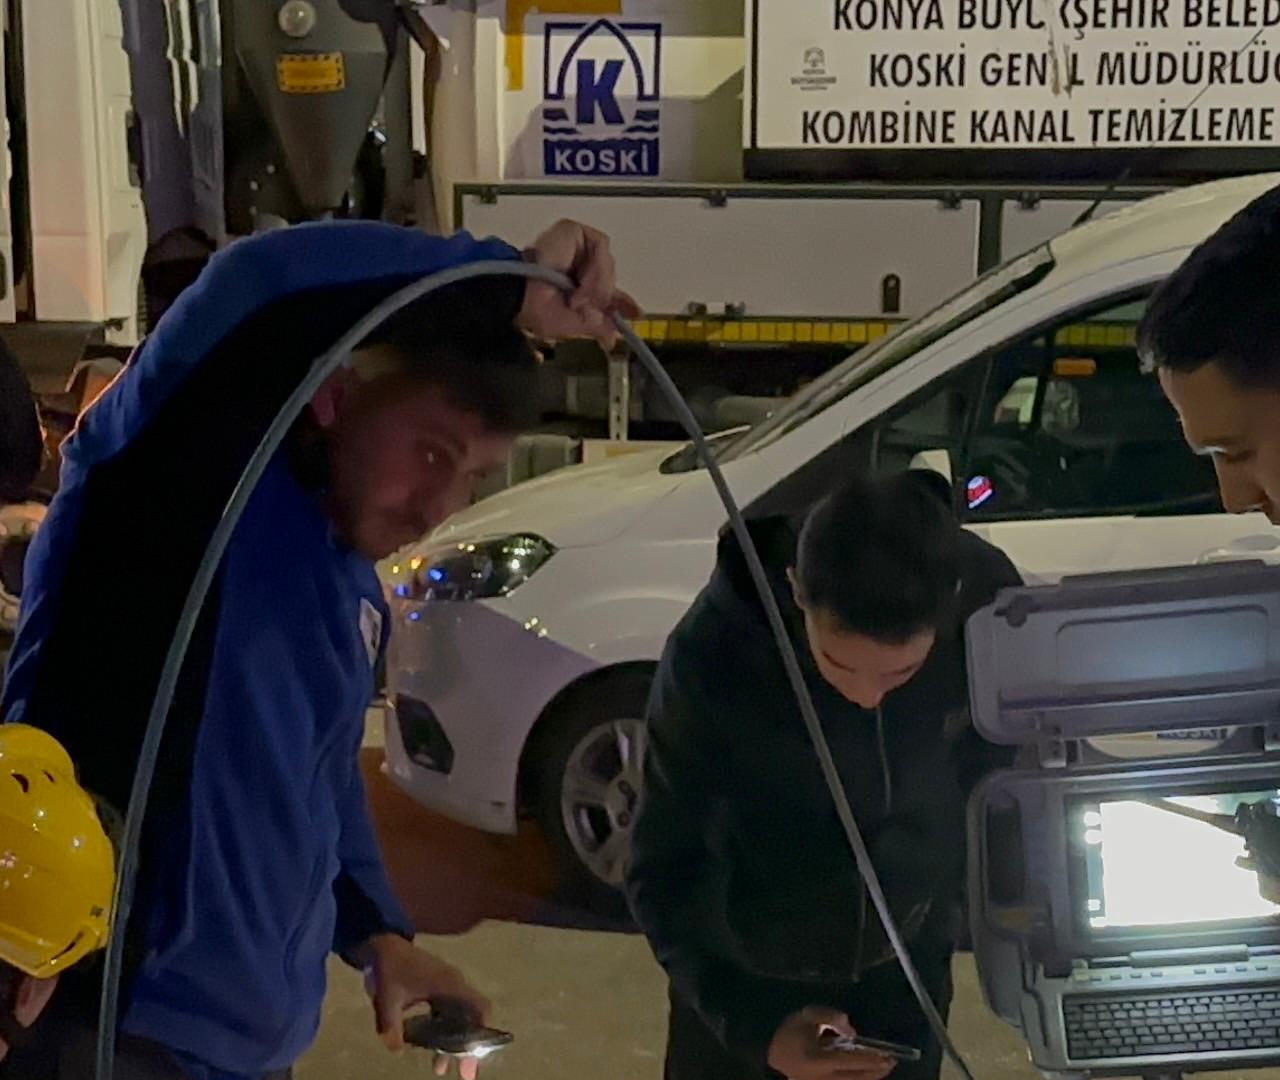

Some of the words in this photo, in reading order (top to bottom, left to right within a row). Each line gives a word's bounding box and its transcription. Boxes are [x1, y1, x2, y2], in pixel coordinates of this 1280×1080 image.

[833, 0, 945, 31] KONYA
[869, 42, 966, 88] KOSKİ
[980, 52, 1085, 88] GENL
[576, 59, 625, 125] K
[801, 100, 957, 145] KOMBİNE
[970, 109, 1076, 143] KANAL
[1088, 98, 1275, 143] TEMİZLEME
[554, 144, 650, 173] KOSKİ
